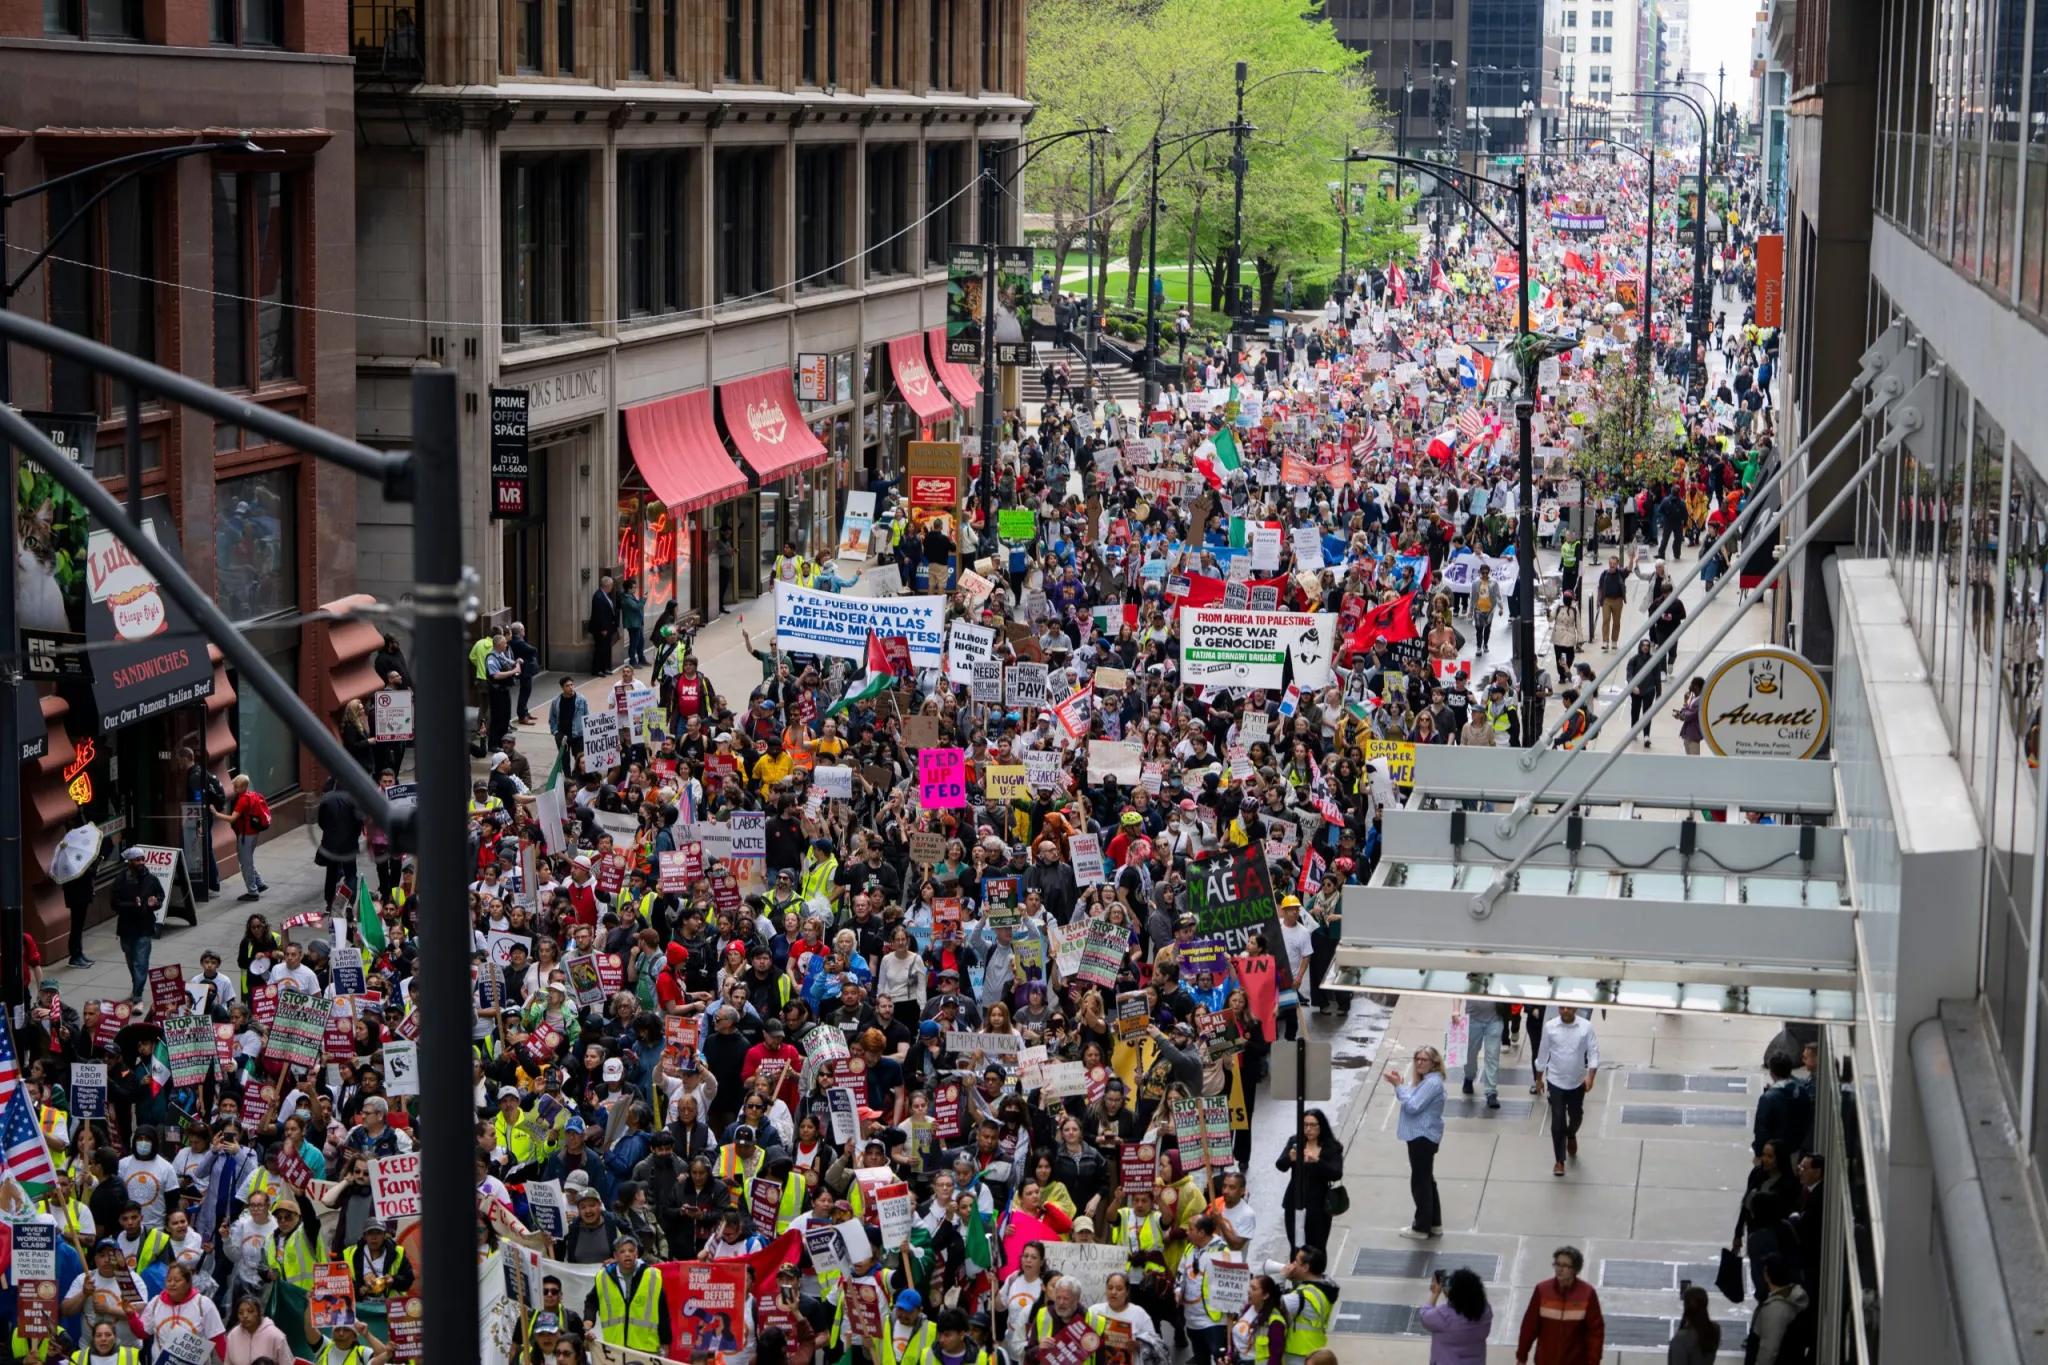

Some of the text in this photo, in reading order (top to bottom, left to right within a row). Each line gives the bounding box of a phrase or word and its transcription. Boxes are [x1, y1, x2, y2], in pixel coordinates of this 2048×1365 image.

[952, 344, 975, 353] CATS
[555, 370, 597, 402] BUILDING
[494, 396, 525, 408] PRIME
[492, 411, 528, 422] OFFICE
[494, 424, 526, 436] SPACE
[51, 430, 65, 444] TO
[500, 455, 520, 464] (312)
[492, 465, 528, 473] 641-5600
[1252, 590, 1276, 601] NEEDS
[808, 597, 909, 615] EL PUEBLO UNIDO
[779, 615, 844, 633] FAMILIAS
[882, 616, 892, 628] A
[896, 618, 926, 630] LAS
[1197, 613, 1315, 626] FROM AFRICA TO PALESTINE:
[954, 631, 989, 645] ILLINOIS
[1192, 625, 1278, 638] OPPOSE WAR
[955, 641, 986, 655] HIGHER
[1193, 637, 1276, 649] & GENOCIDE!
[1414, 640, 1426, 648] OF
[1192, 650, 1216, 660] FATIMA
[1249, 652, 1277, 662] BRIGADE
[1397, 645, 1422, 658] THIS
[112, 649, 190, 689] SANDWICHES
[973, 666, 1000, 680] NEEDS
[1019, 668, 1040, 678] MAKE
[682, 686, 698, 695] PSL
[1017, 682, 1045, 699] PAY!
[104, 680, 211, 730] Our Own Famous Italian Beef
[583, 713, 616, 728] Families
[1711, 703, 1817, 726] Avanti
[589, 723, 617, 736] BELONG
[23, 739, 43, 759] Beef
[1370, 741, 1398, 751] GRAD
[1735, 740, 1753, 748] Pizza,
[922, 752, 959, 768] FED
[1044, 752, 1060, 763] OFF
[927, 768, 951, 784] UP
[992, 774, 1025, 786] NUGW
[1026, 770, 1061, 783] ESEARCH
[388, 786, 408, 796] STOP
[924, 784, 961, 798] FED
[732, 815, 764, 830] LABOR,
[732, 837, 764, 849] UNITE
[998, 882, 1010, 890] ALL
[1189, 867, 1265, 909] MAGA
[1197, 896, 1274, 933] EXICANS
[1093, 921, 1129, 940] STOP THE
[283, 992, 330, 1011] STOP THE
[165, 1016, 210, 1030] STOP THE
[950, 1035, 1018, 1050] IMPEACH NOW
[1174, 1097, 1226, 1112] STO THE
[378, 1156, 418, 1175] KEEP
[378, 1178, 423, 1197] Fami
[376, 1199, 420, 1217] TOGE
[1080, 1244, 1098, 1261] NO
[688, 1273, 711, 1283] STOP
[1214, 1273, 1249, 1281] TAXPAYER
[688, 1282, 735, 1291] DEPORTATIONS
[1217, 1280, 1243, 1290] DATA!
[704, 1290, 735, 1300] DEFEND
[1216, 1290, 1244, 1298] REJECT
[688, 1299, 735, 1309] IMMIGRANTS
[25, 1324, 48, 1333] Illega
[173, 1337, 205, 1355] LABOR
[182, 1333, 201, 1347] END
[168, 1344, 202, 1362] ABUSE!
